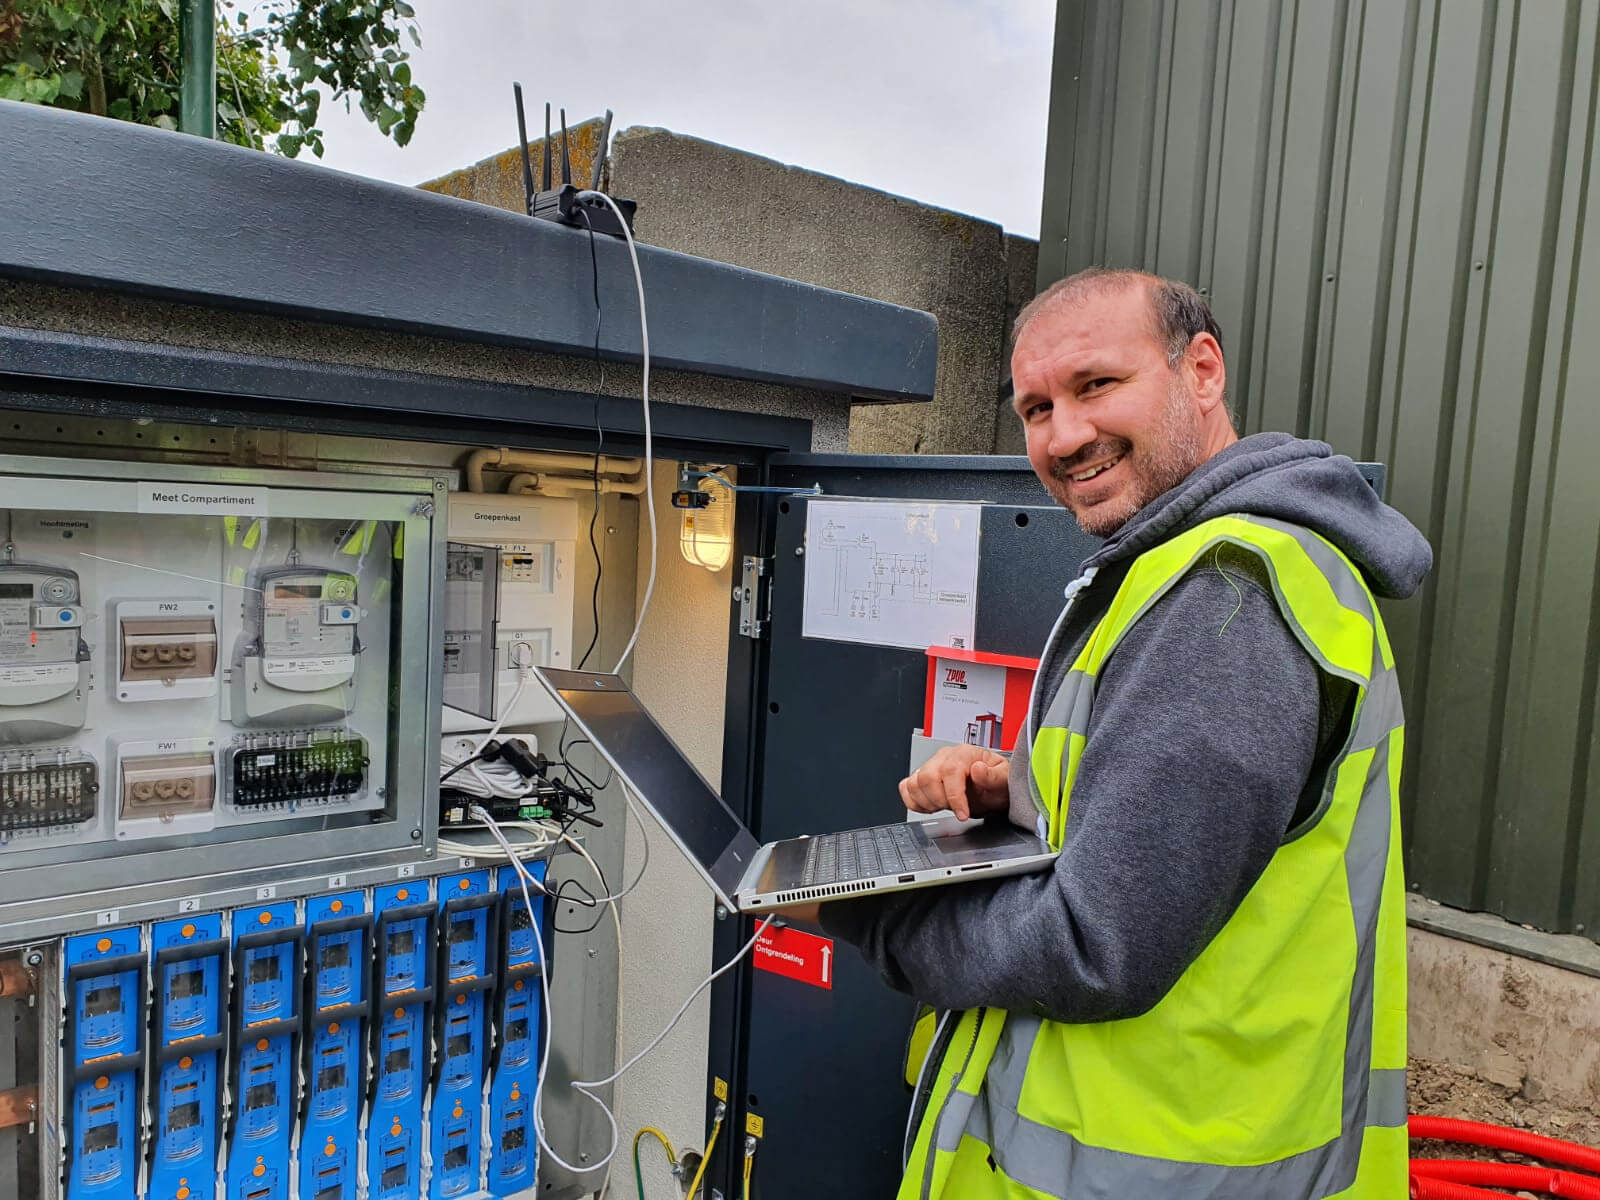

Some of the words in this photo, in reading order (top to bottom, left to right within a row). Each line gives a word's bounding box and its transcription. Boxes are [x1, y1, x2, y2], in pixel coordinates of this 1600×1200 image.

[152, 493, 178, 502] Meet
[181, 494, 255, 505] Compartiment
[474, 513, 521, 522] Groepenkast
[464, 859, 470, 867] 6
[403, 867, 409, 876] 5
[333, 877, 341, 886] 4
[263, 888, 270, 898] 3
[186, 901, 193, 911] 2
[755, 944, 805, 966] Ontgrendeling
